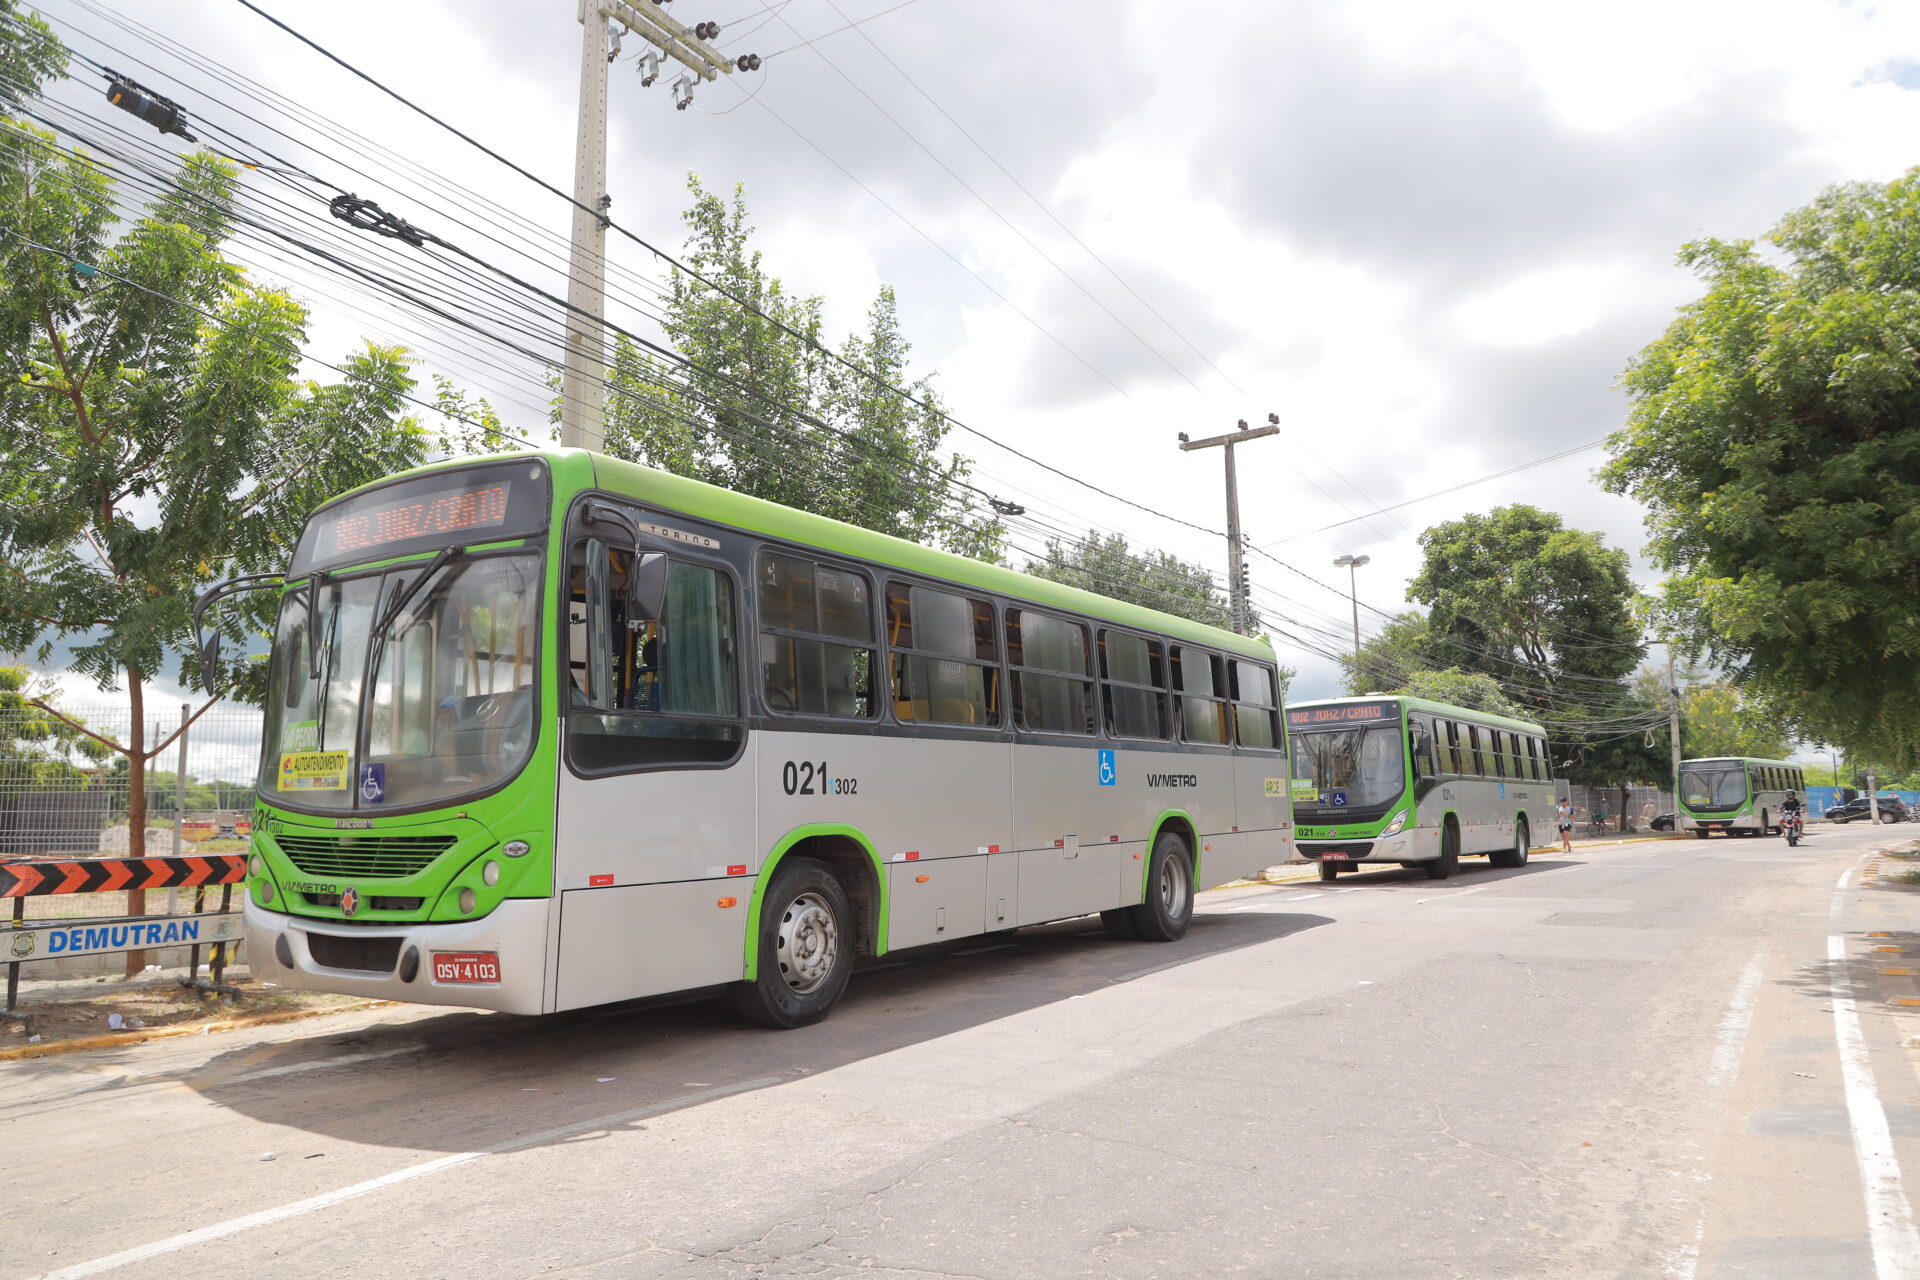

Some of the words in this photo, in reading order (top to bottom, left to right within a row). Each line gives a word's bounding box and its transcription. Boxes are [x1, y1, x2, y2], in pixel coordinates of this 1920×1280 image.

[650, 525, 710, 546] TORINO
[294, 754, 344, 772] AUTOATENDIMENTO
[1146, 773, 1198, 788] VIAMETRO
[1298, 828, 1314, 836] 021
[281, 880, 337, 894] VIAMETRO
[48, 920, 200, 953] DEMUTRAN
